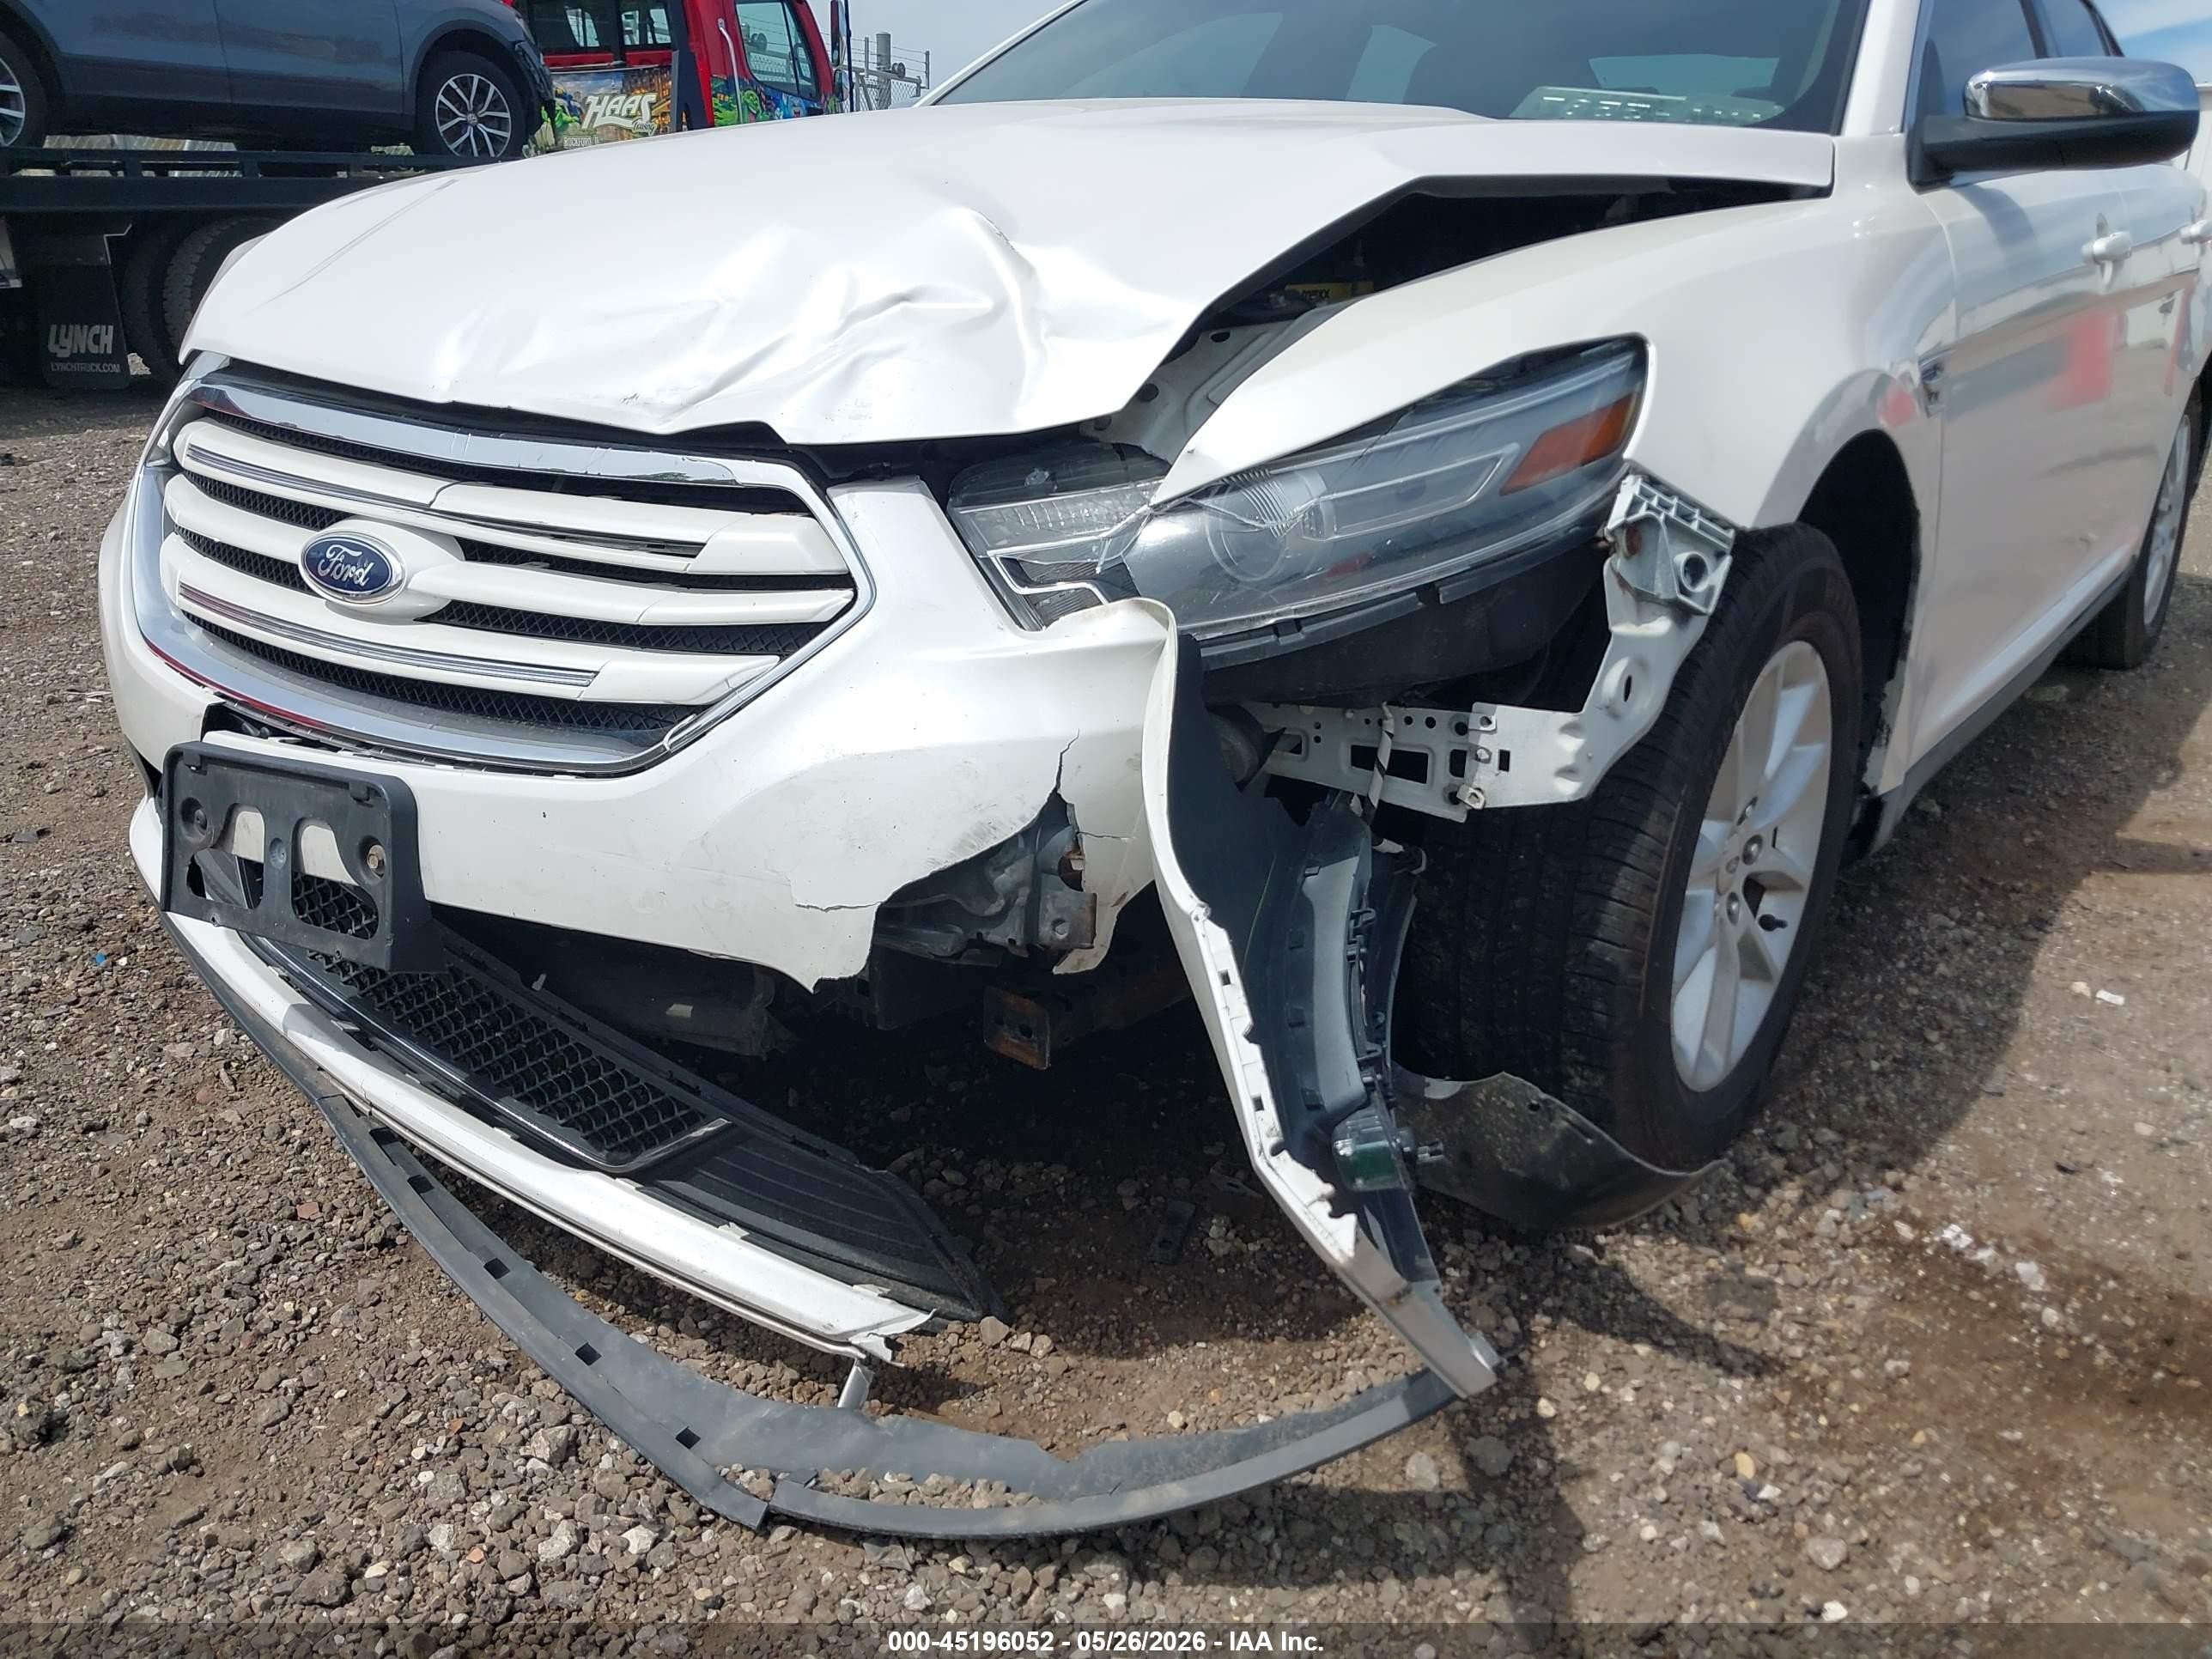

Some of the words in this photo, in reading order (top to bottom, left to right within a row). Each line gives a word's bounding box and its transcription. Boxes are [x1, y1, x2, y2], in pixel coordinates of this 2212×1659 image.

[581, 93, 658, 130] HAAS
[48, 325, 113, 357] LYNCH
[52, 362, 120, 373] LYNCHTRUCK.COM
[317, 544, 374, 586] Ford
